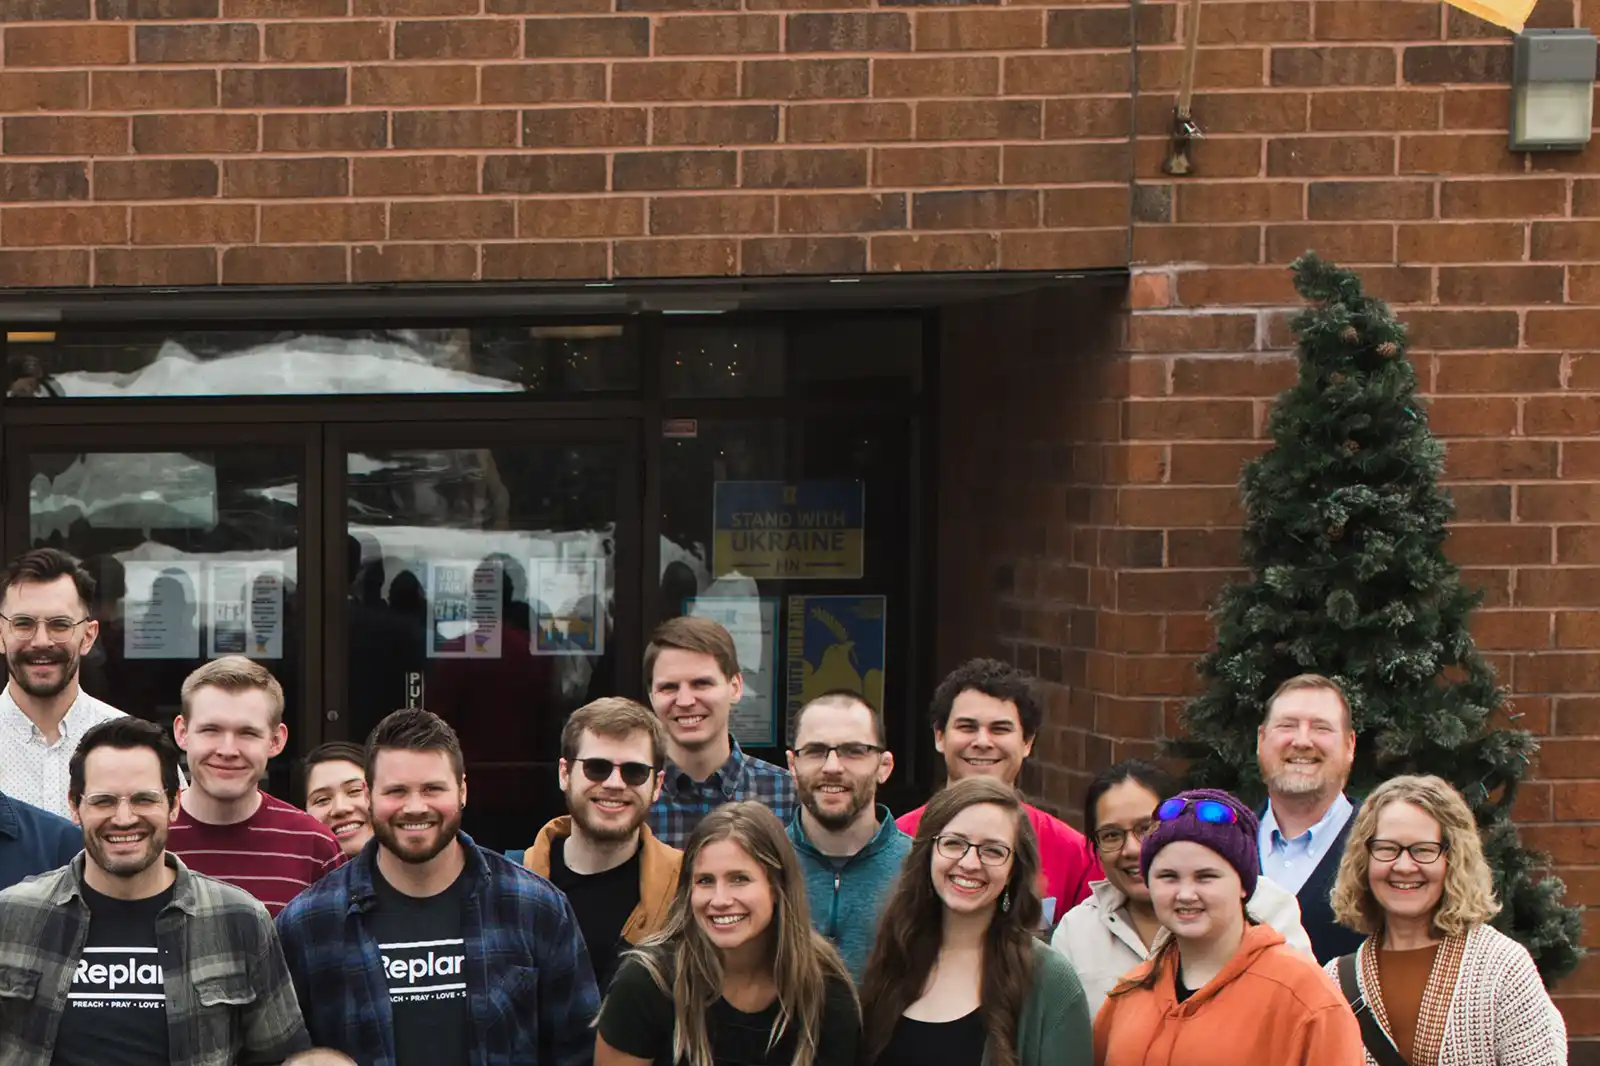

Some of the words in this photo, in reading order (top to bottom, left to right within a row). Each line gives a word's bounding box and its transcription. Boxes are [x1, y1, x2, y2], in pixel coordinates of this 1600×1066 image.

[731, 512, 792, 528] STAND
[798, 510, 845, 527] WITH
[731, 531, 846, 552] UKRAINE
[72, 1000, 104, 1008] PREACH
[410, 994, 429, 1002] PRAY
